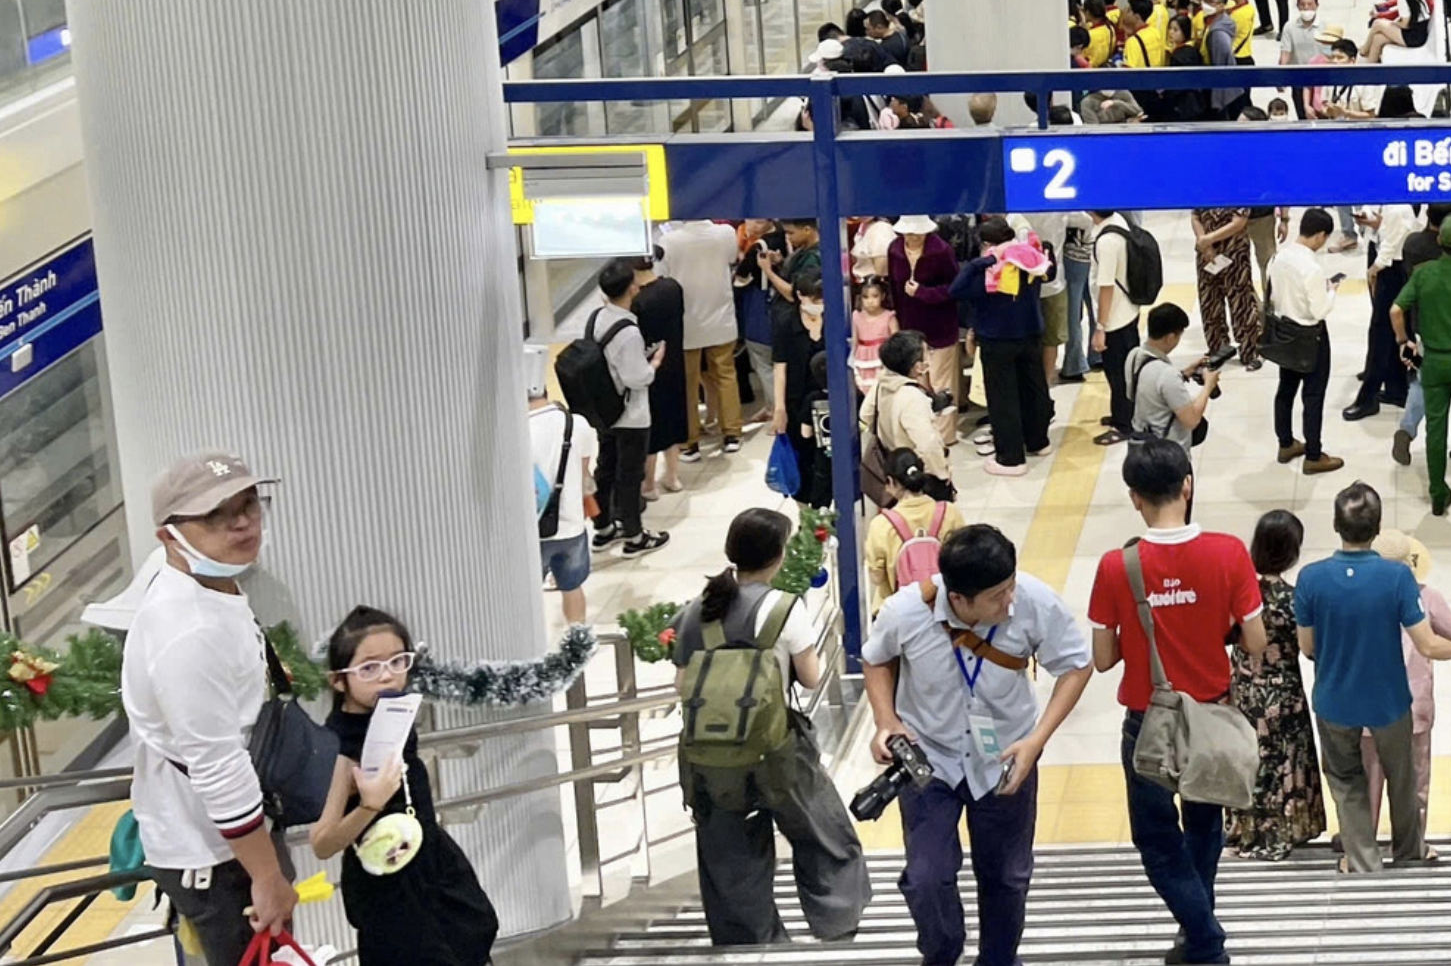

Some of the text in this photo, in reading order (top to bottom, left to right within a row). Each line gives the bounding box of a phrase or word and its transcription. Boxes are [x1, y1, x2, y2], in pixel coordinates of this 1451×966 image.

[1382, 139, 1408, 168] đi
[1043, 148, 1078, 200] 2
[1406, 171, 1435, 192] for
[0, 269, 57, 319] ến Thành
[17, 300, 47, 328] Thanh
